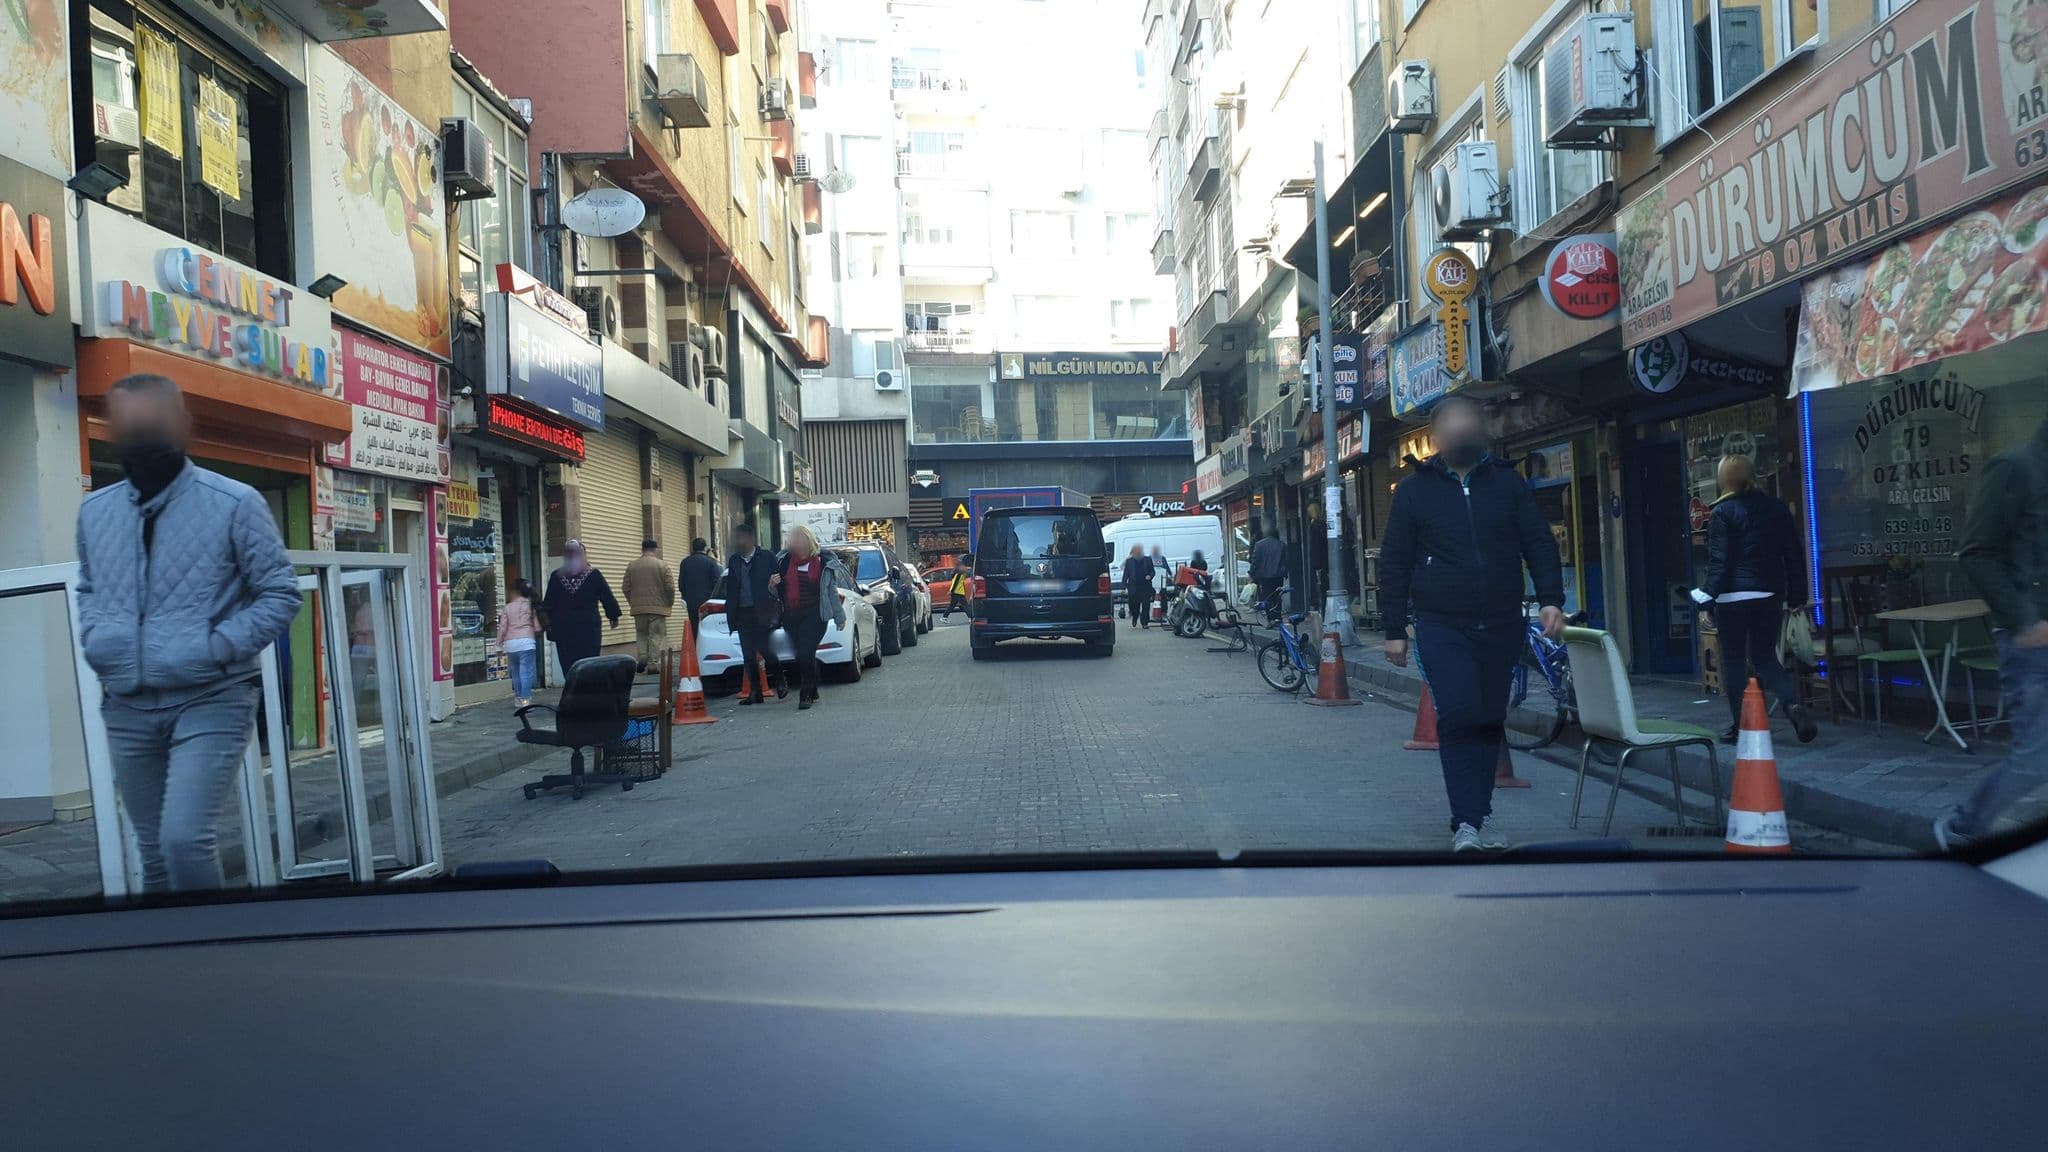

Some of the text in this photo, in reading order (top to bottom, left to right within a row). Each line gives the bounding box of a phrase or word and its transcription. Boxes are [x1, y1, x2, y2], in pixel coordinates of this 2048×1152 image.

[1671, 3, 1996, 288] DÜRÜMCÜM
[1566, 247, 1604, 268] KALE
[1747, 249, 1776, 289] 79
[167, 247, 293, 327] CENNET
[1435, 264, 1468, 284] KALE
[114, 280, 333, 388] MEYVE SULARI
[1449, 300, 1460, 368] ANAHTARCI
[1029, 357, 1096, 375] NİLGÜN
[1097, 361, 1148, 375] MODA
[492, 400, 525, 433] İPHONE
[1854, 371, 1985, 453] DÜRÜMCÜM
[1903, 425, 1931, 450] 79
[1139, 495, 1185, 516] Ayvaz
[1887, 489, 1909, 504] ARA
[1885, 516, 1952, 534] 639 40 48
